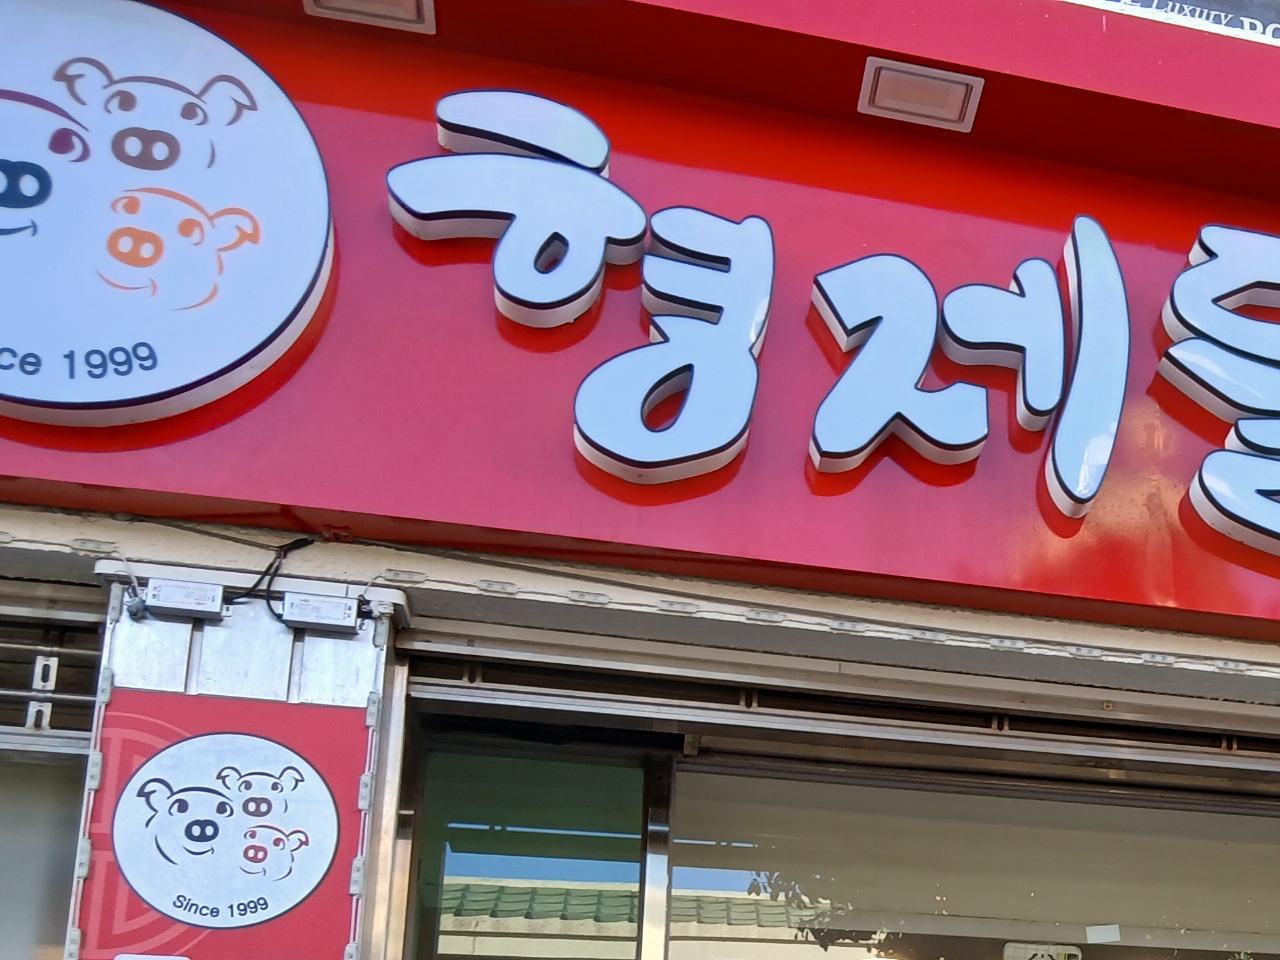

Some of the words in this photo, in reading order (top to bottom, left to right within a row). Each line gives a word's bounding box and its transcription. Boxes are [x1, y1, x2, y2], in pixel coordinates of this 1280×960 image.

[62, 341, 158, 380] 1999
[172, 893, 221, 919] Since
[227, 895, 270, 919] 1999
